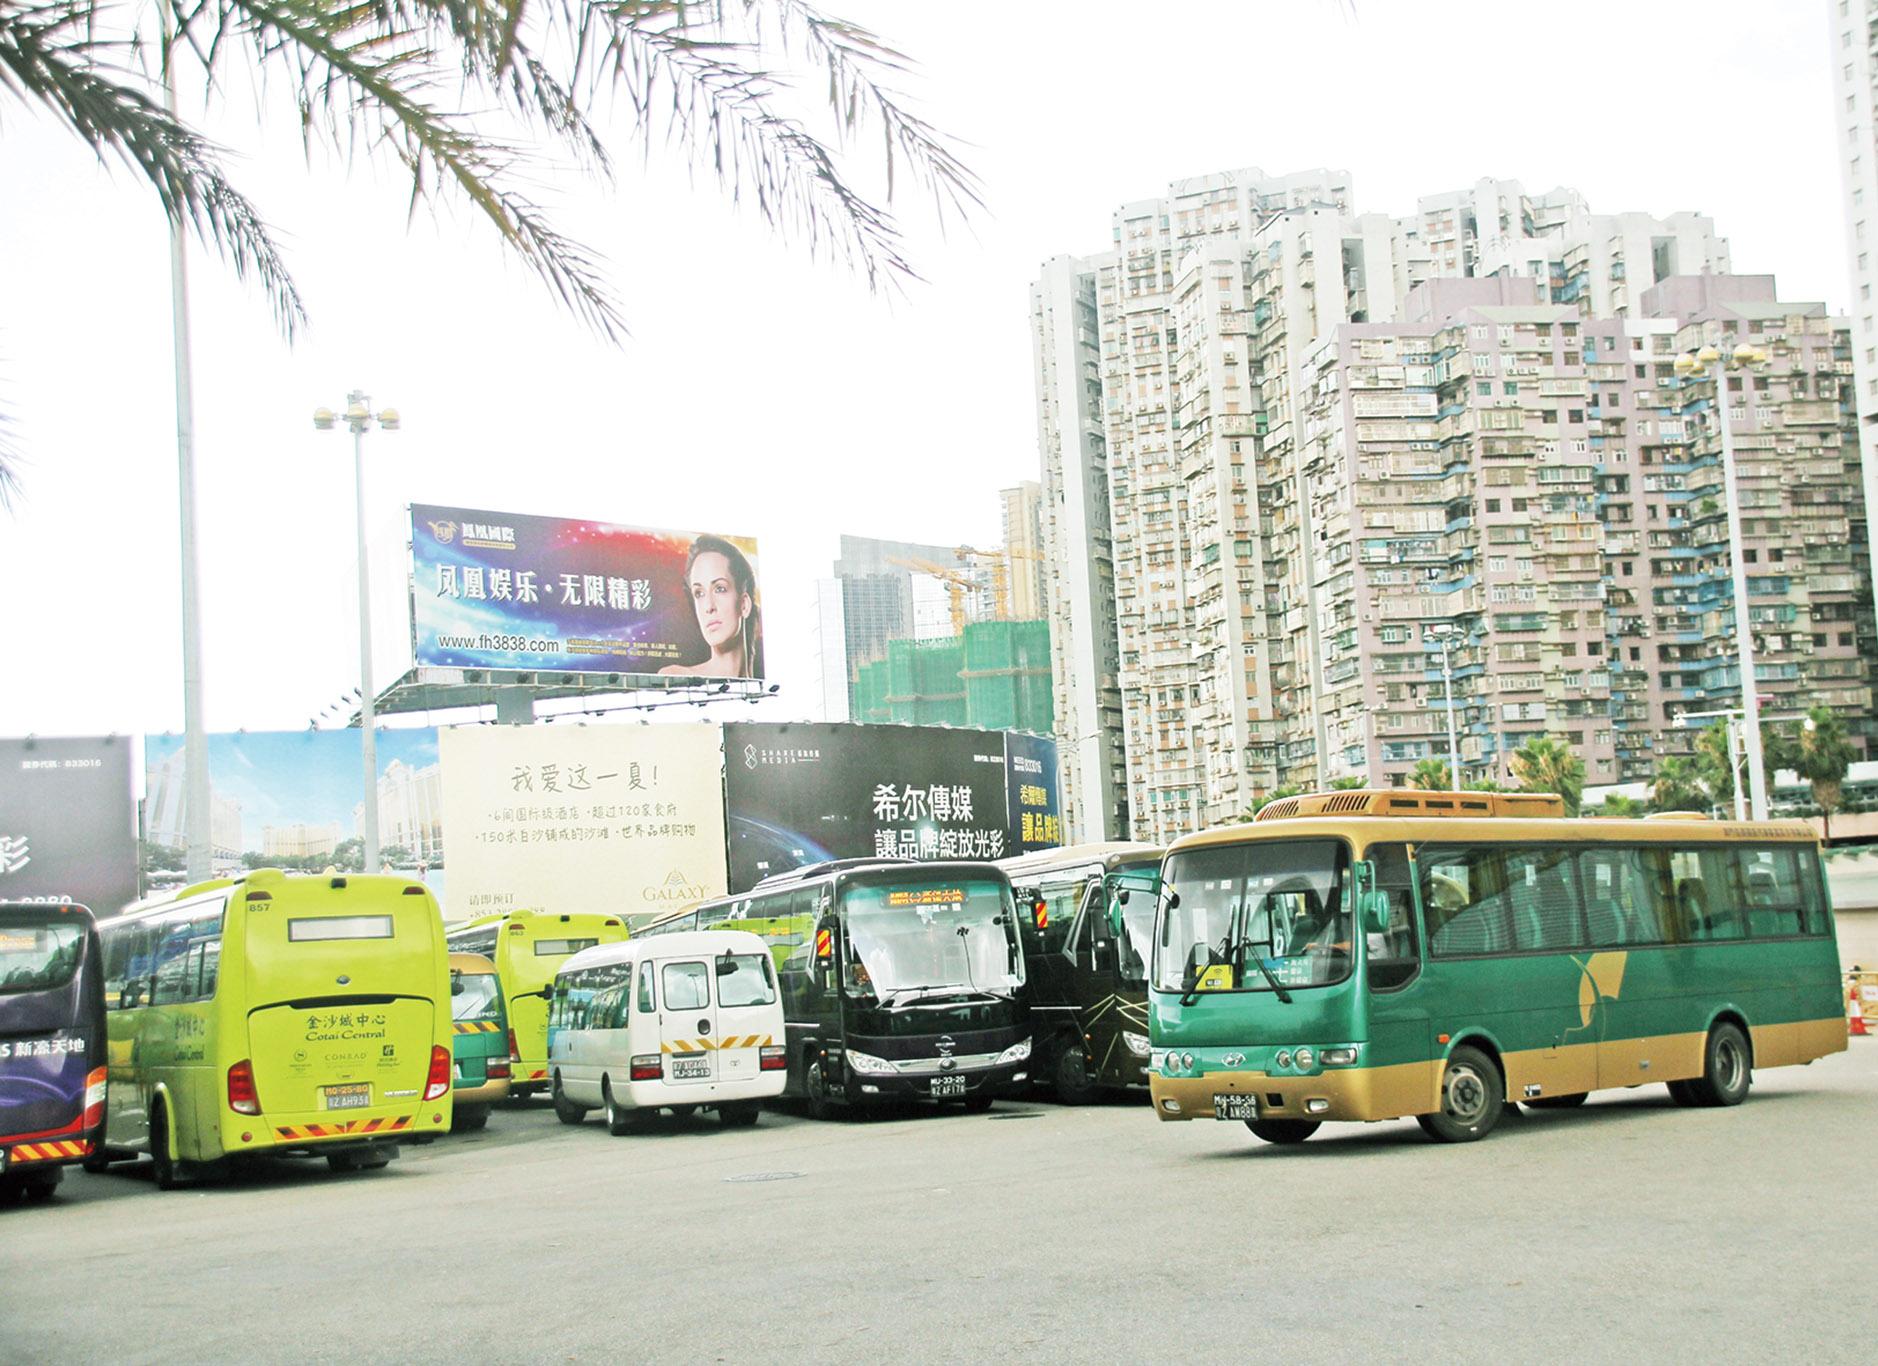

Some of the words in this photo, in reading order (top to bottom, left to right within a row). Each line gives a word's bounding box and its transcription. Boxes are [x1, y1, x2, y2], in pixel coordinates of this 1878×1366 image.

[436, 563, 652, 611] 凤凰娱乐·无限精彩
[438, 634, 559, 652] www.fh3838.com
[511, 761, 658, 793] 我爱这一夏!
[873, 784, 973, 822] 希尔傳媒
[643, 885, 707, 901] GALAXY
[249, 904, 271, 912] 857
[305, 1031, 340, 1041] Cotai
[341, 1029, 385, 1040] Central
